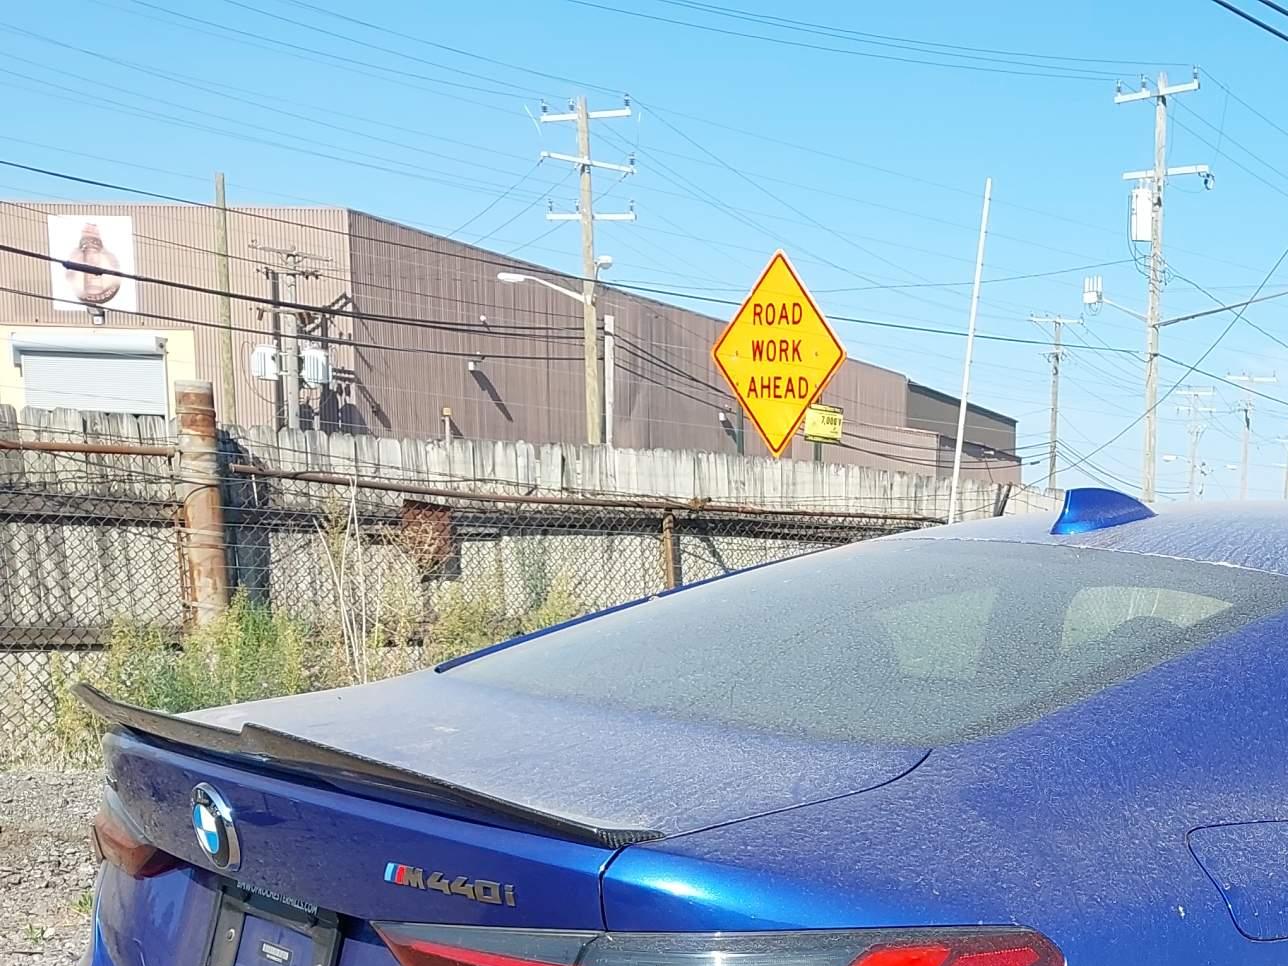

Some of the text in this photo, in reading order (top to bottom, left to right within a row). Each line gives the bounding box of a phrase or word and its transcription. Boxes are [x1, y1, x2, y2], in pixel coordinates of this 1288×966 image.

[753, 303, 803, 326] ROAD
[752, 340, 803, 362] WORK
[747, 376, 809, 399] AHEAD
[403, 866, 516, 907] M440i
